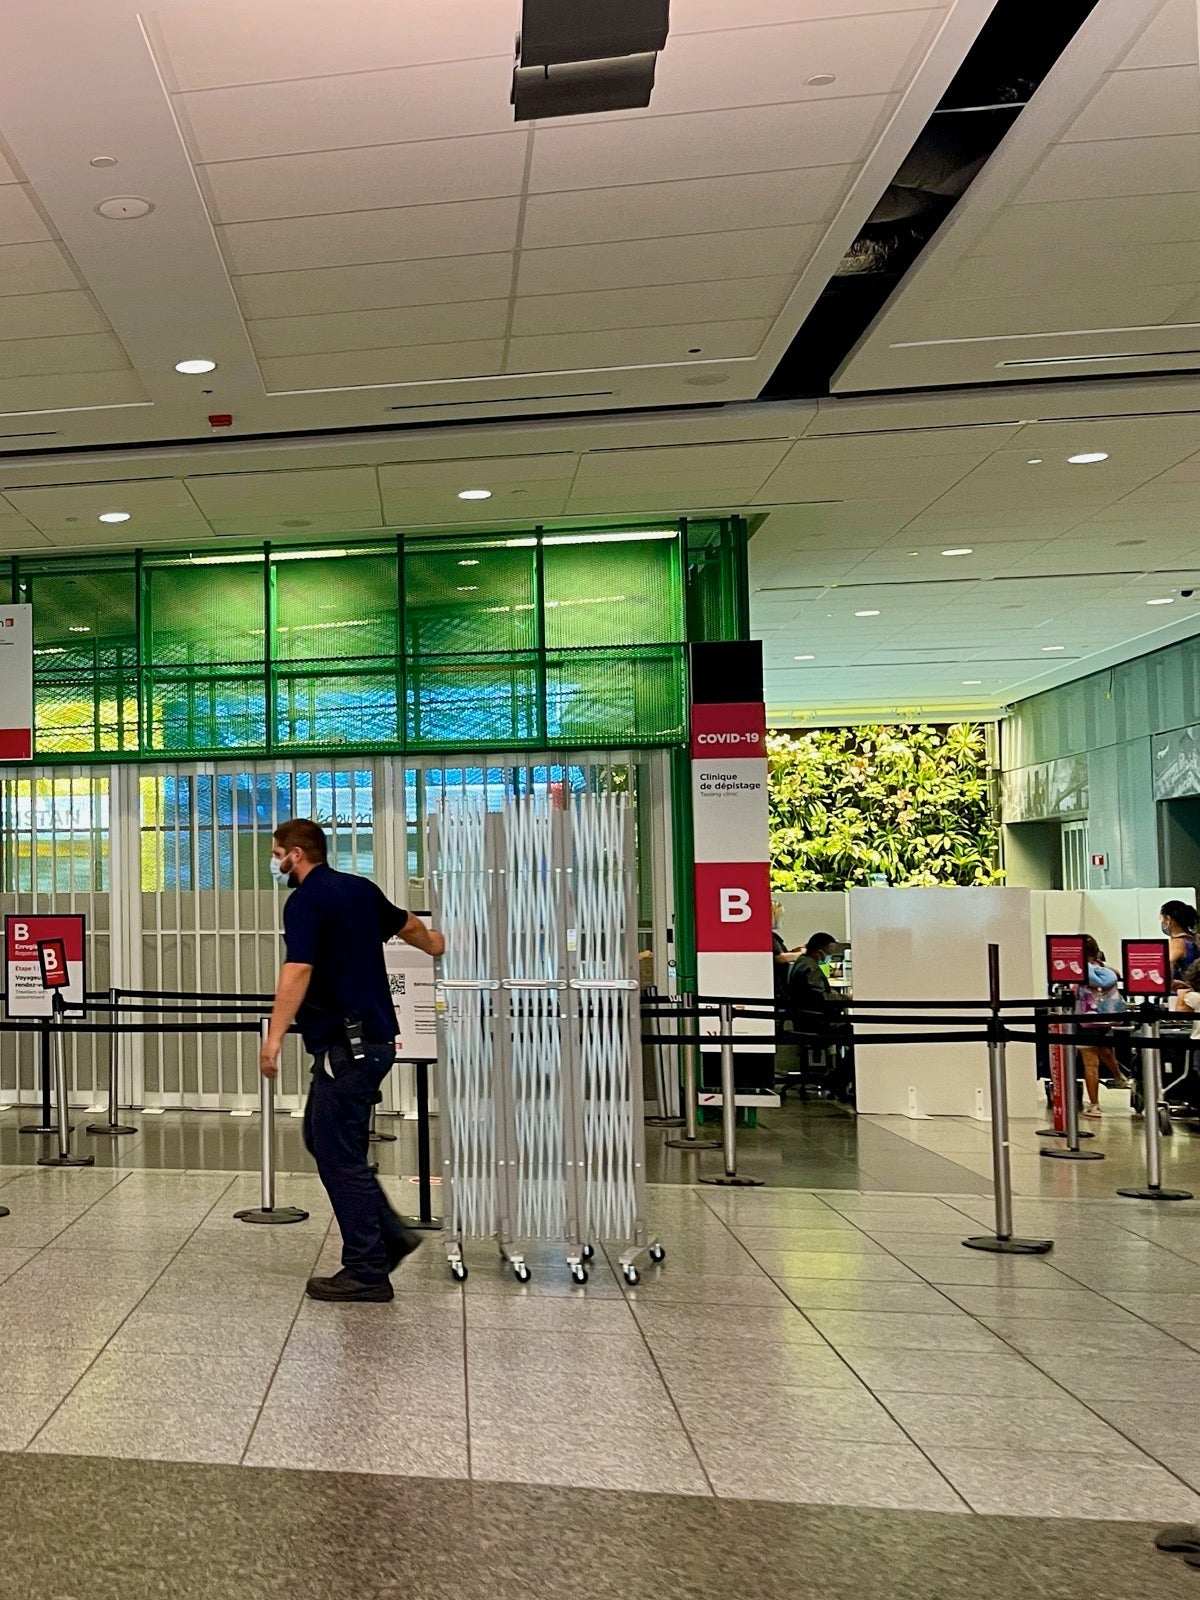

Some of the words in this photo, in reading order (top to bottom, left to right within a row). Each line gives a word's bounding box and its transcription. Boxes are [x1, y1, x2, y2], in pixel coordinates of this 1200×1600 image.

[697, 733, 760, 744] COVID-19
[700, 773, 738, 782] Clinique
[714, 782, 761, 790] dépistage
[720, 888, 752, 923] B
[14, 923, 29, 941] B
[43, 949, 58, 970] B
